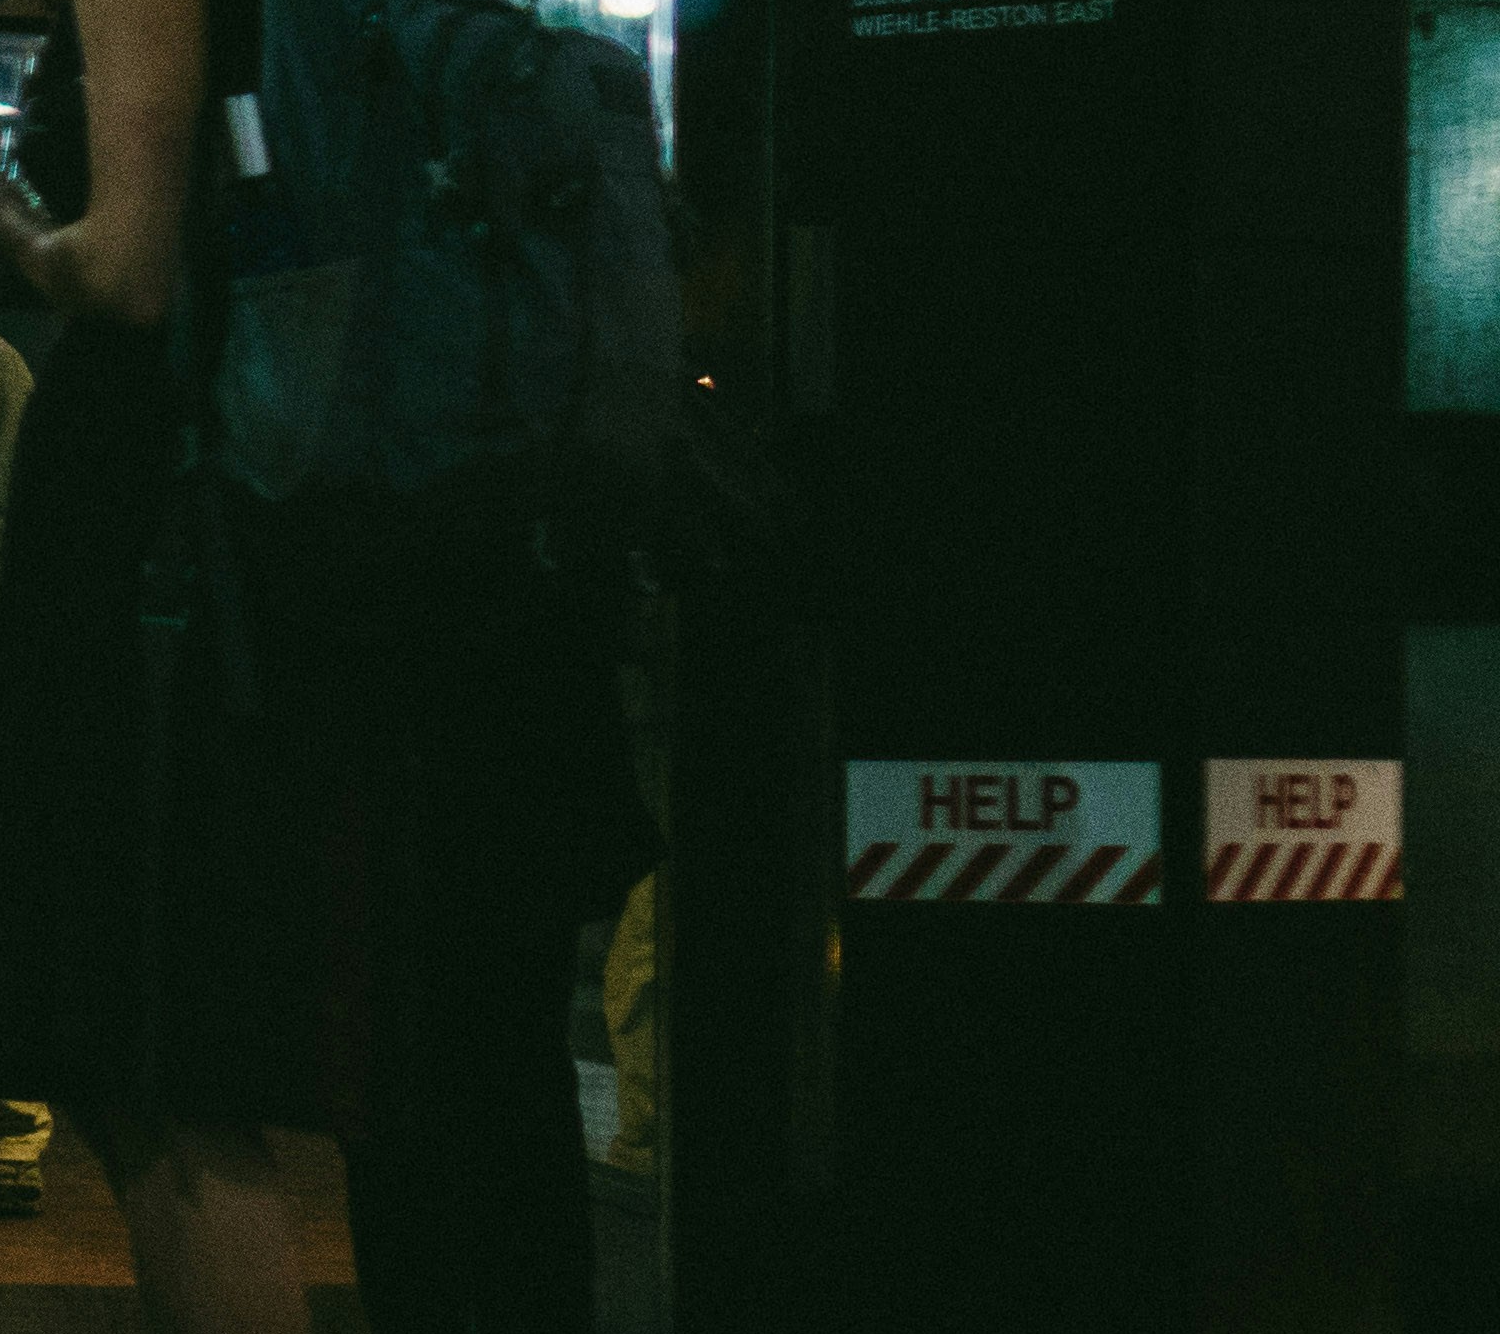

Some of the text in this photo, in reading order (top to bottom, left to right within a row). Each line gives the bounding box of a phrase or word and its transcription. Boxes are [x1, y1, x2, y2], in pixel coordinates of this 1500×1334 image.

[851, 5, 1047, 38] WIEHLE-RESTON
[919, 773, 1080, 831] HELP
[1256, 773, 1358, 829] HELP
